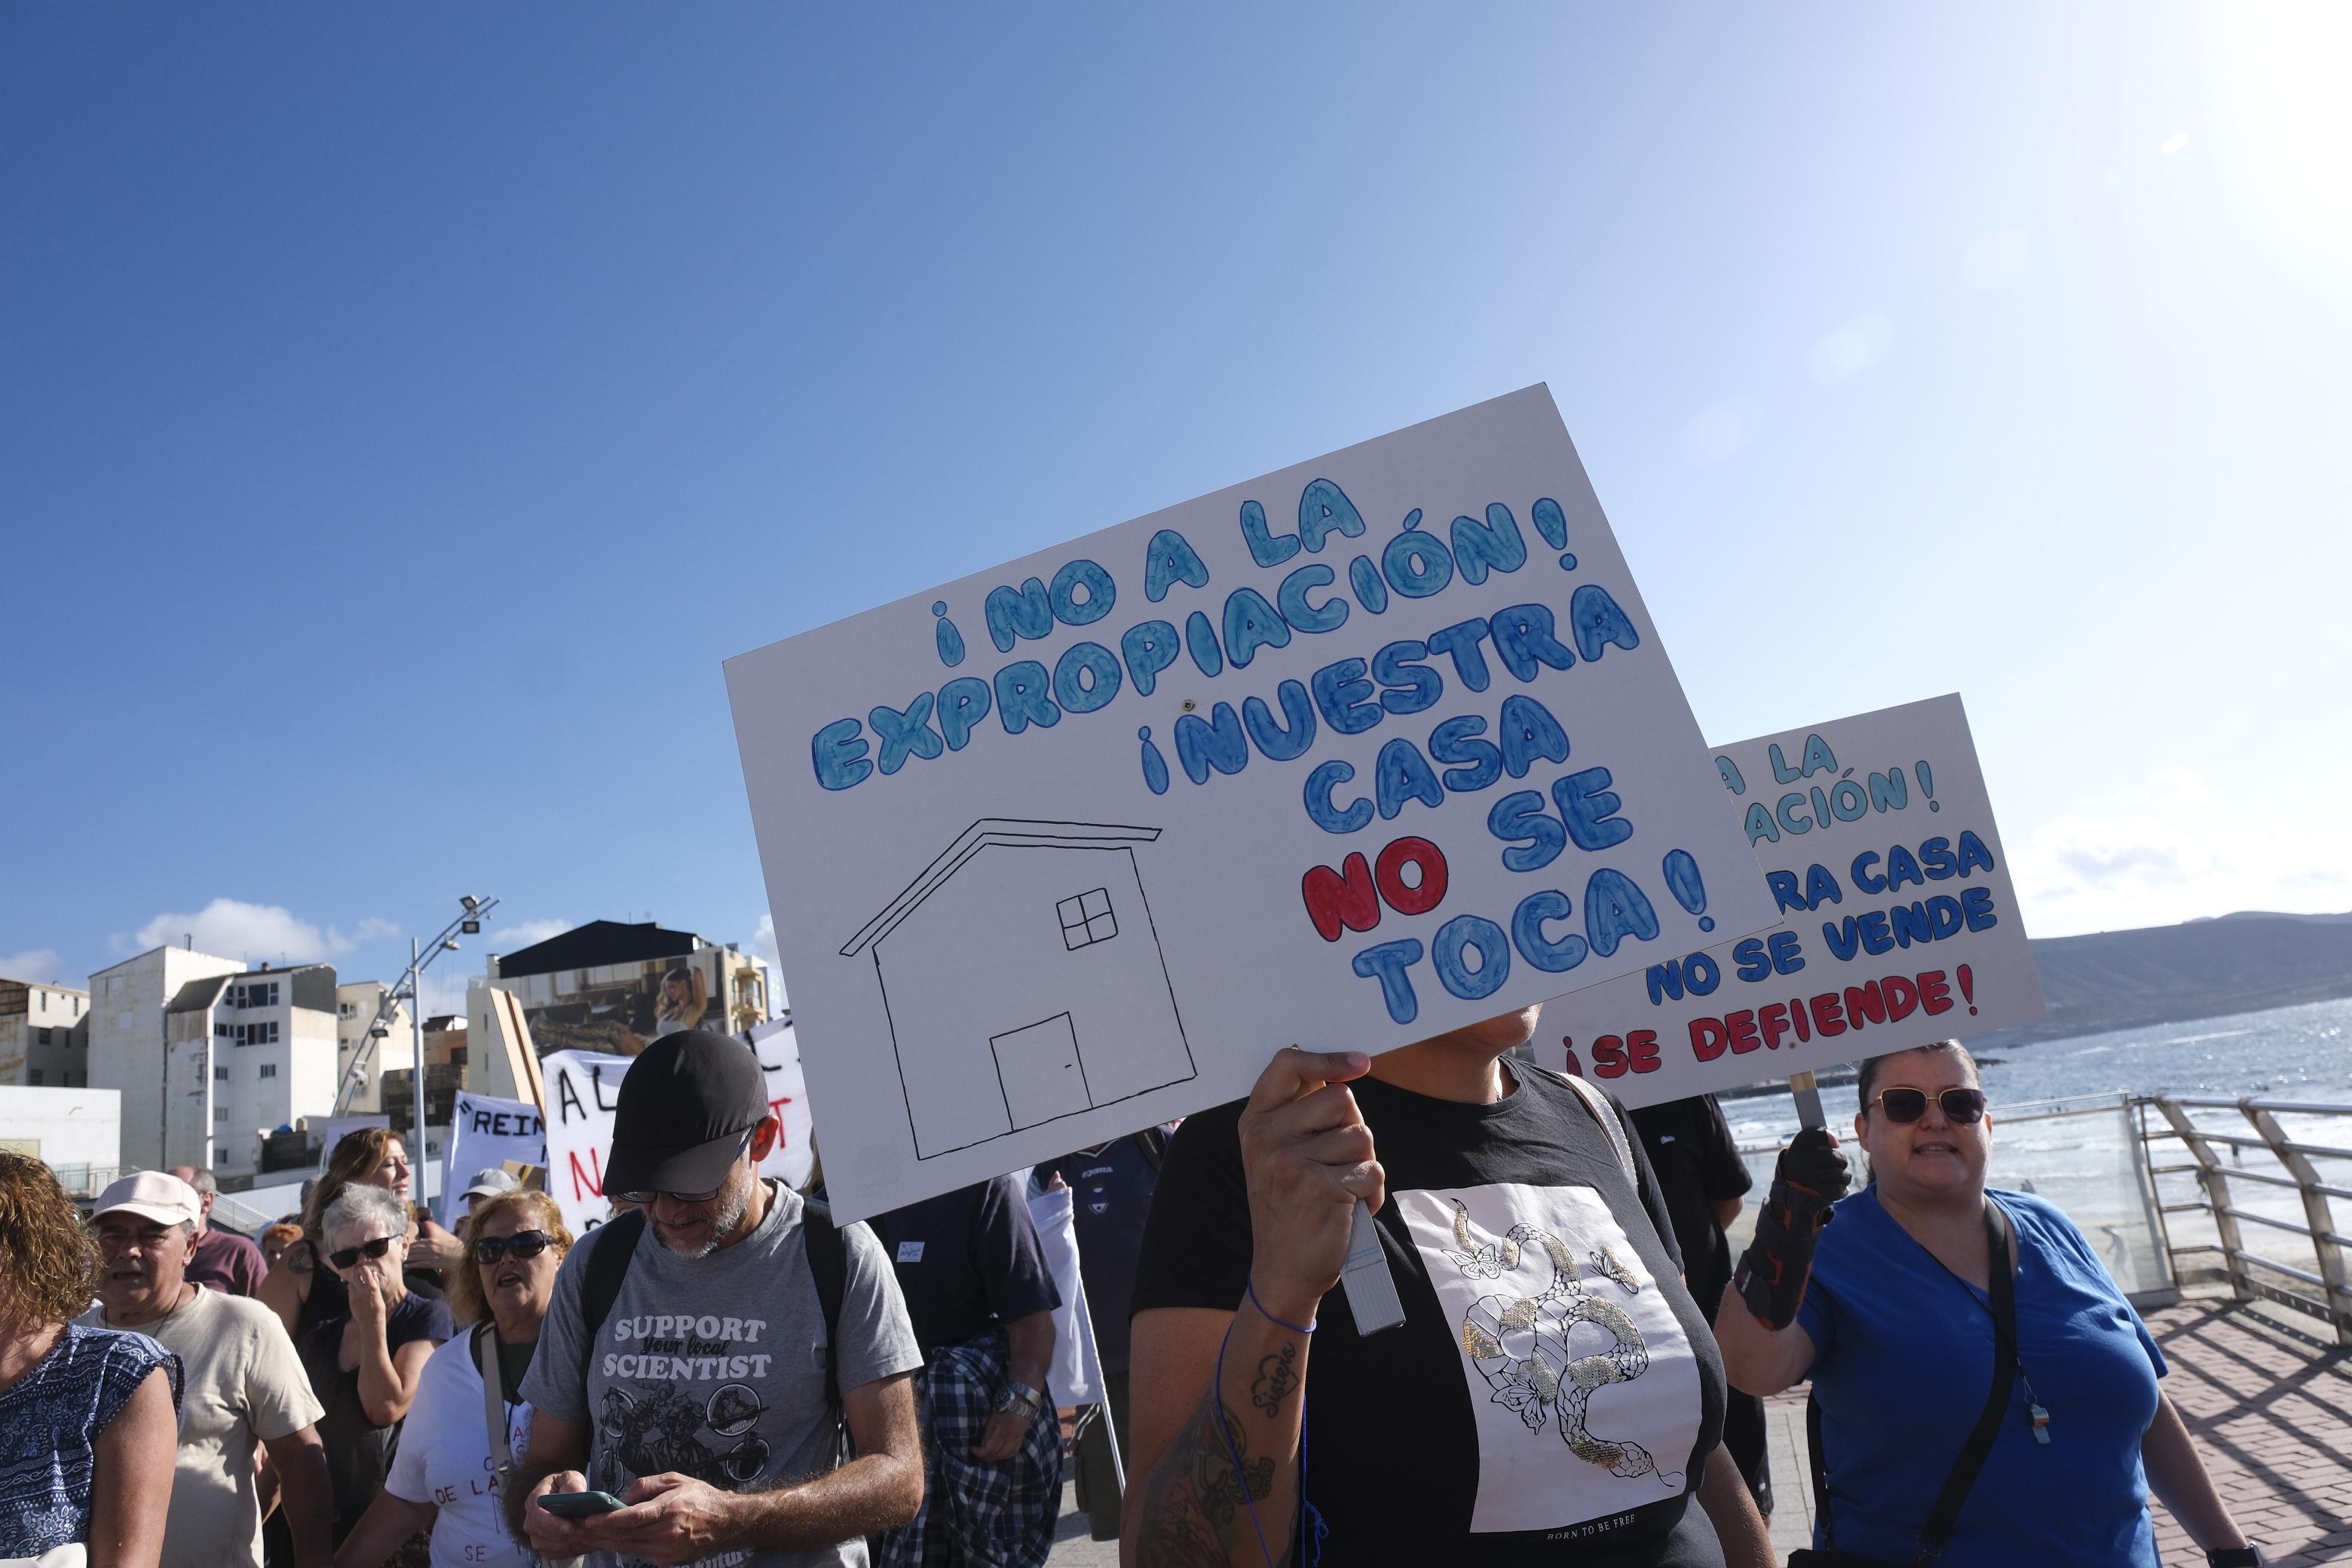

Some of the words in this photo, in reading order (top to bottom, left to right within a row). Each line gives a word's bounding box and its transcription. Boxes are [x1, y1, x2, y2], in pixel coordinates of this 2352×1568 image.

[1144, 529, 1210, 603] A
[1239, 478, 1366, 568] LA
[811, 498, 1578, 792] EXPROPIACIÓN!
[1138, 583, 1640, 795] ¡NUESTRA
[1303, 694, 1572, 835] CASA
[1714, 755, 1746, 795] A
[1769, 733, 1839, 785] LA
[1301, 835, 1449, 943] NO
[1487, 766, 1635, 873] SE
[1851, 830, 1995, 895] CASA
[1352, 848, 1717, 1025] TOCA!
[1646, 952, 1720, 1006] NO
[1733, 930, 1806, 983] SE
[1823, 887, 1998, 961] VENDE
[1688, 963, 1978, 1063] DEFIENDE!
[603, 1353, 772, 1380] SCIENTIST
[614, 1315, 767, 1343] SUPPORT
[641, 1337, 683, 1355] your
[687, 1335, 730, 1356] local
[464, 1545, 486, 1563] SE
[1547, 1530, 1578, 1539] BORN
[1582, 1525, 1594, 1536] TO
[1597, 1521, 1610, 1533] BE
[1613, 1514, 1635, 1529] FREE
